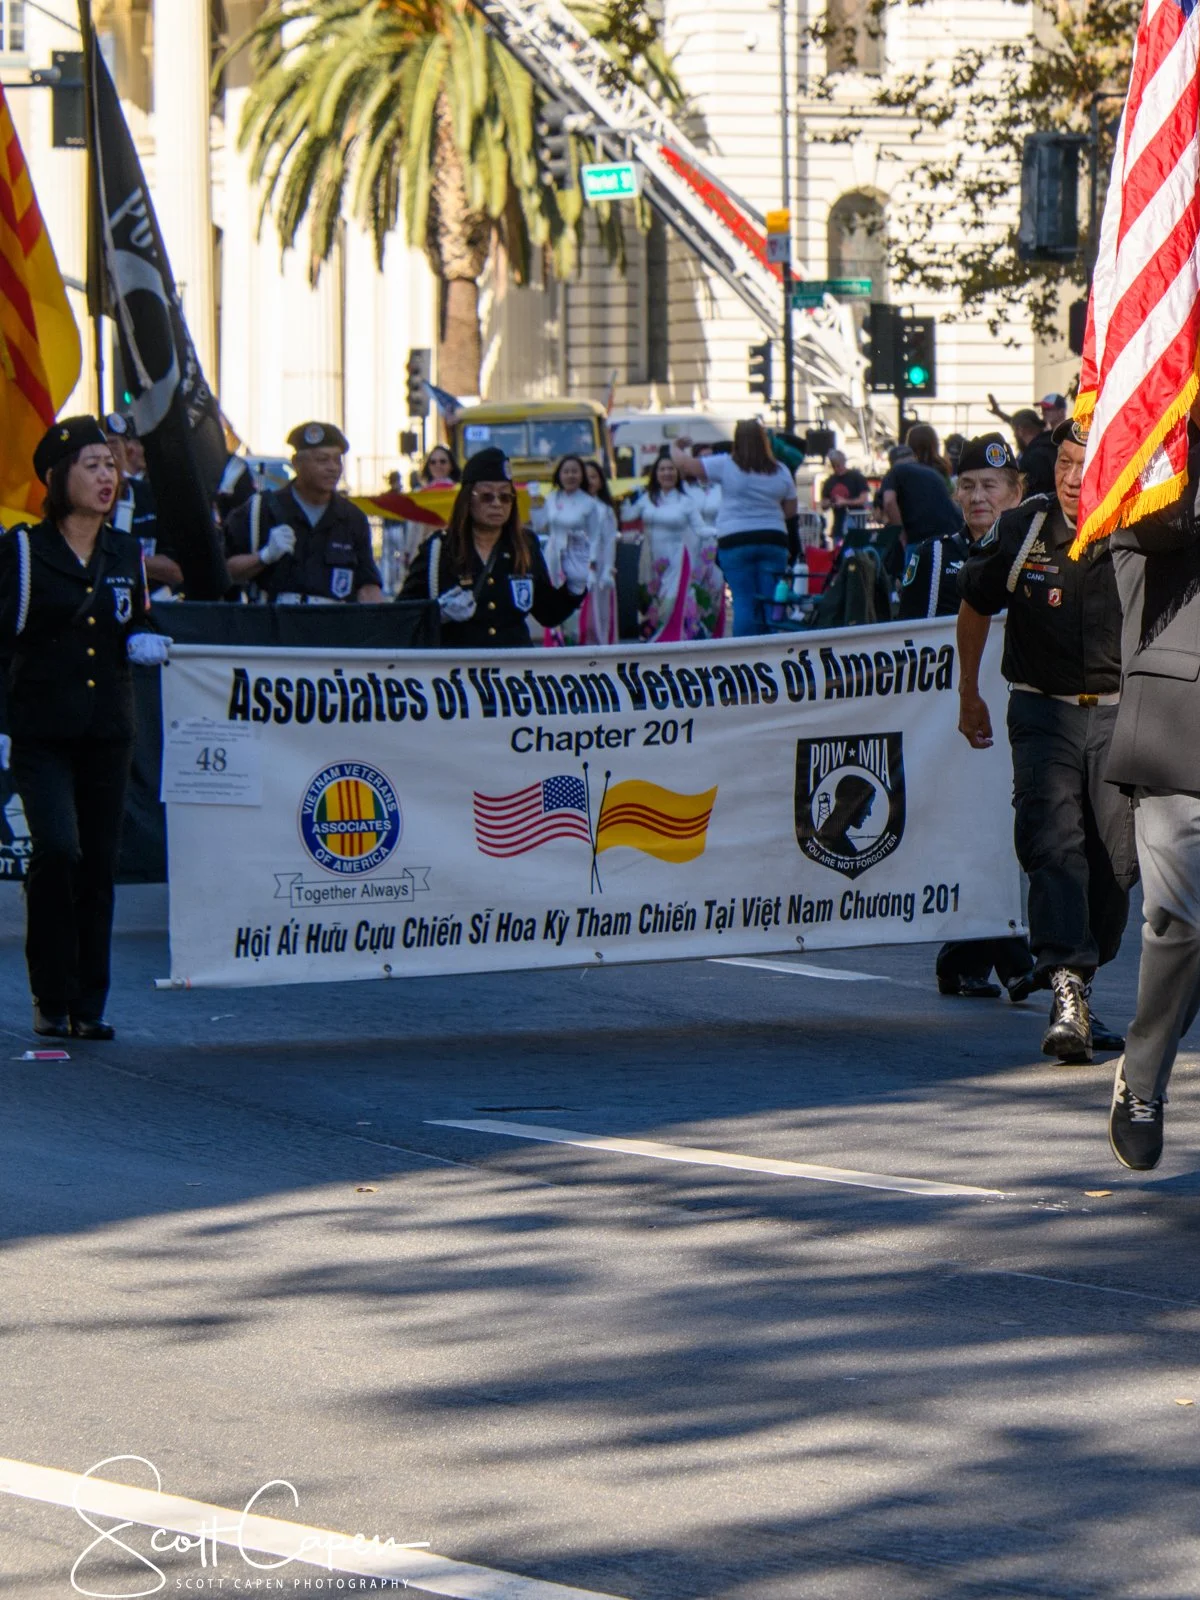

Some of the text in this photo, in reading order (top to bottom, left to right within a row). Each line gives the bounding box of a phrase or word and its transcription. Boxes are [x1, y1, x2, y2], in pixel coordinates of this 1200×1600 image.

[228, 639, 955, 725] Associates of Vietnam Veterans of America
[510, 718, 695, 757] Chapter 201
[196, 746, 227, 772] 48
[809, 738, 892, 797] POW MIA
[303, 765, 397, 815] VIETNAM VETERANS
[312, 819, 392, 834] ASSOCIATES
[314, 846, 390, 873] OF AMERICA
[805, 833, 898, 870] YOU ARE NOT FORGOTTEN
[294, 883, 409, 904] Together Always
[235, 924, 272, 962] Hội
[354, 920, 397, 955] Cựu
[402, 913, 463, 949] Chiến
[495, 911, 537, 943] Hoa
[543, 908, 570, 946] Kỳ
[575, 907, 632, 938] Tham
[638, 901, 697, 934] Chiến
[704, 898, 736, 935] Tại
[742, 896, 782, 932] Việt
[786, 894, 834, 925] Nam
[839, 890, 916, 923] Chương
[922, 883, 960, 915] 201
